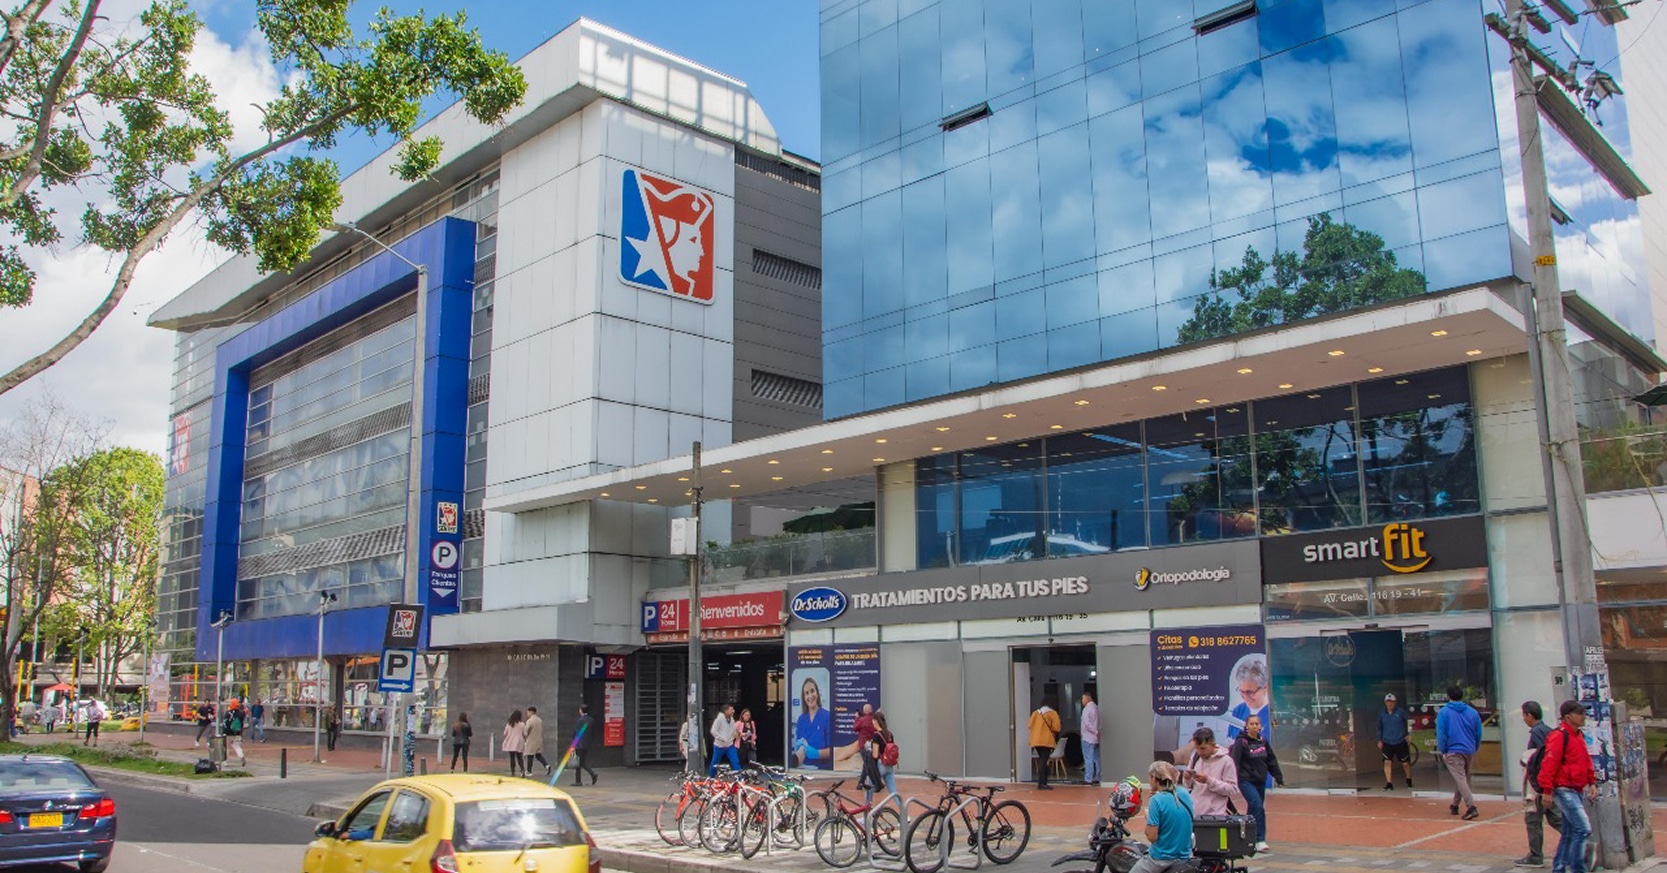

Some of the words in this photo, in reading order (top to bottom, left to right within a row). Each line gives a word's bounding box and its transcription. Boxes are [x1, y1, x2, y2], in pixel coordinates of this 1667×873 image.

[1303, 537, 1380, 563] smart
[1383, 523, 1428, 561] fit
[439, 546, 451, 563] P
[1150, 565, 1230, 585] Ortopodología
[852, 584, 966, 610] TRATAMIENTOS
[970, 582, 1015, 601] PARA
[1016, 578, 1050, 598] TUS
[1051, 575, 1089, 596] PIES
[644, 606, 656, 628] P
[661, 603, 675, 619] 24
[1157, 634, 1183, 645] Citas
[386, 654, 408, 676] P
[591, 656, 604, 675] P
[609, 657, 624, 670] 24
